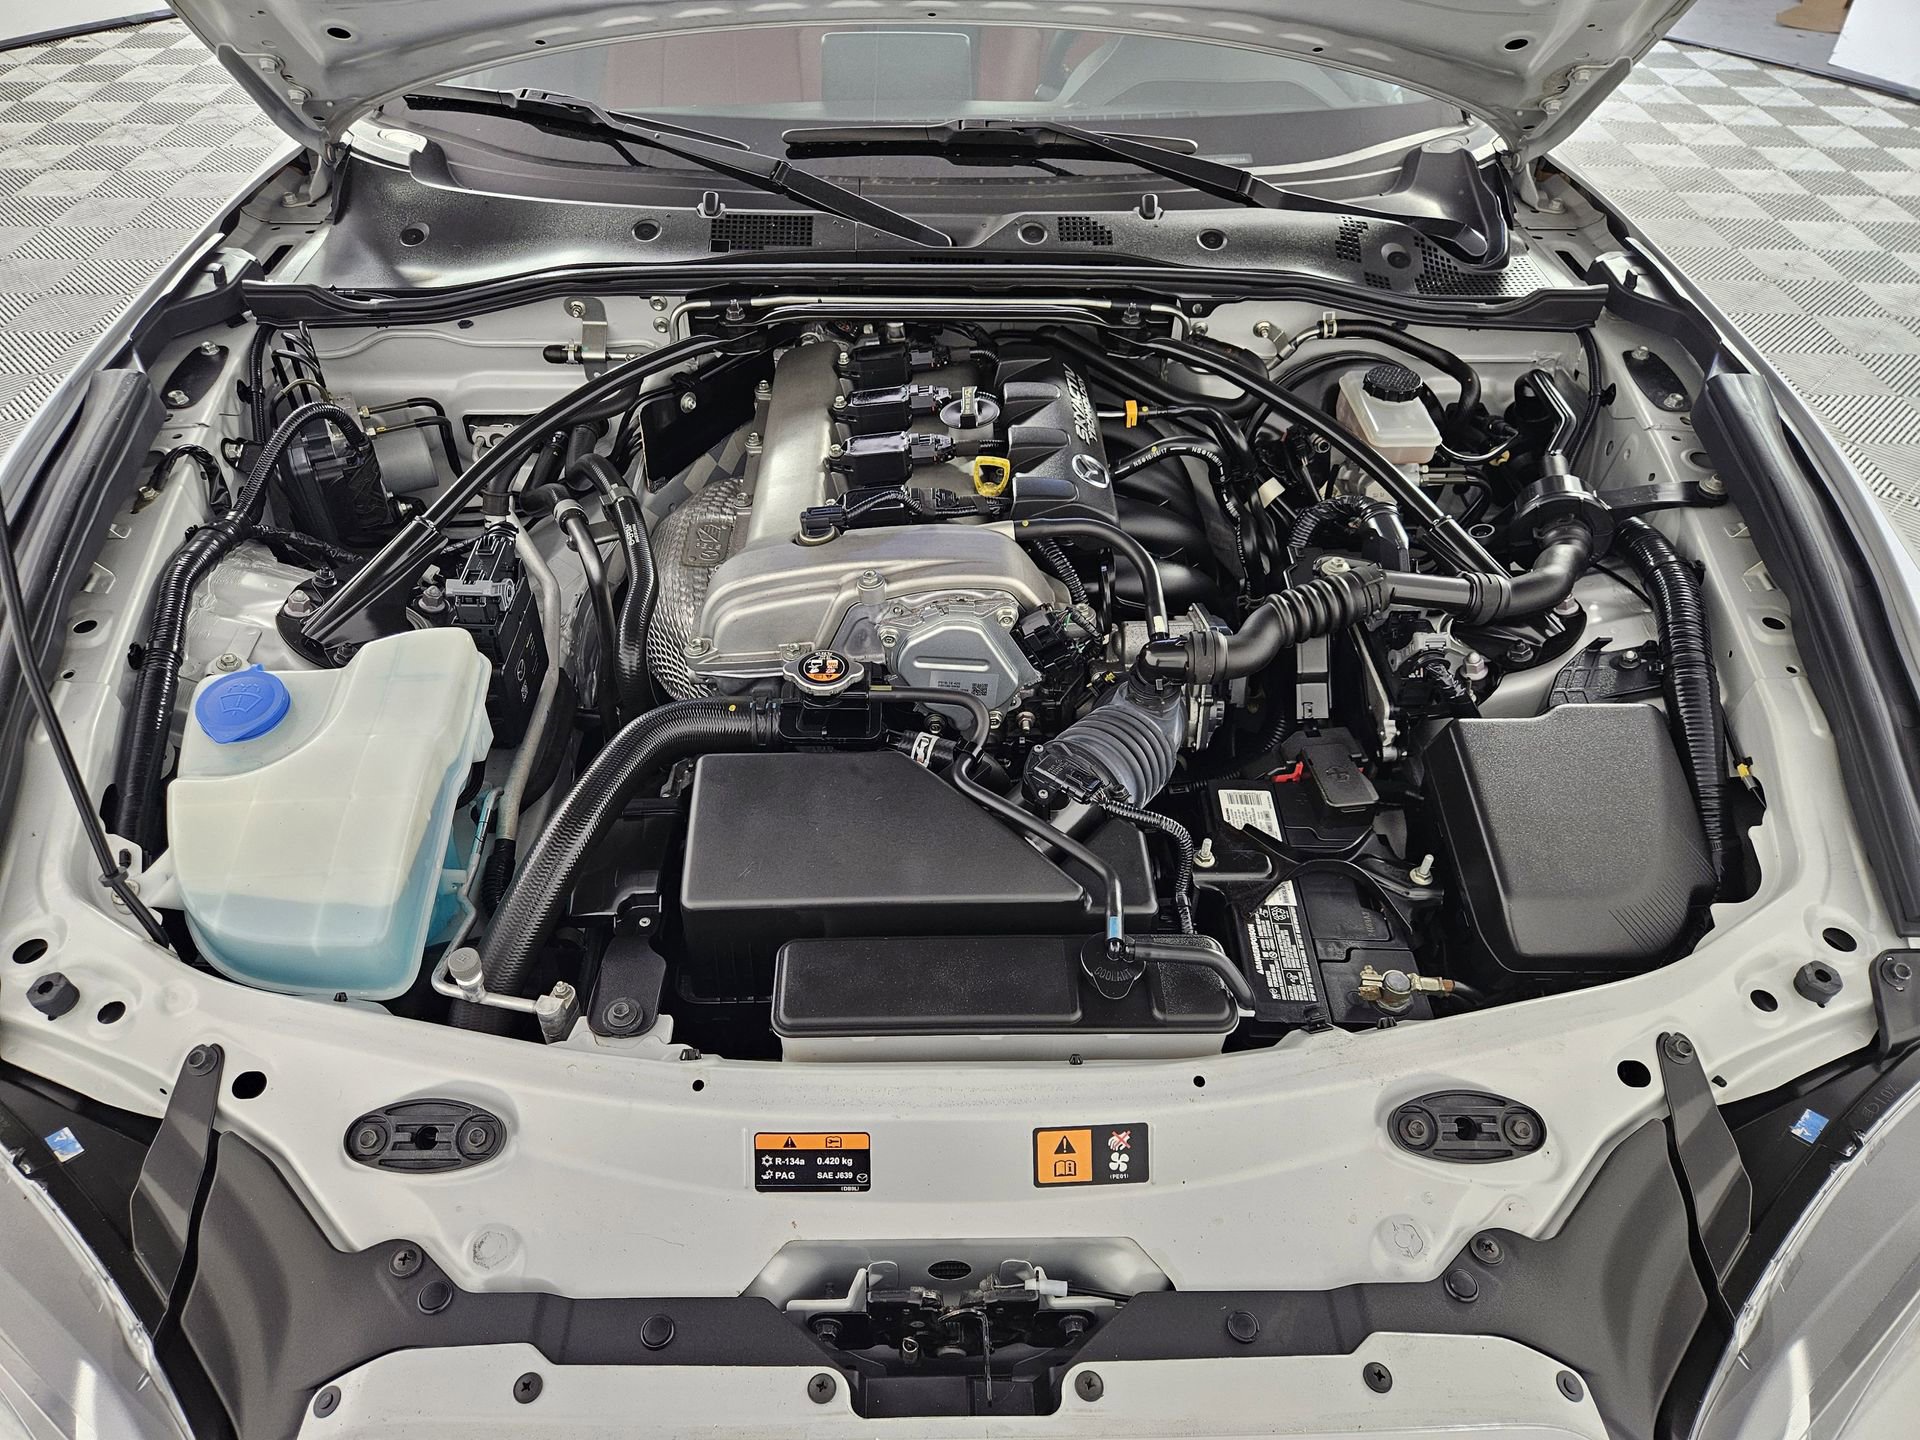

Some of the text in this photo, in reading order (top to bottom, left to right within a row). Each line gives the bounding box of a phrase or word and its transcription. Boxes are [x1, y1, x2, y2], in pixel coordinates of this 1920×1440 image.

[1062, 362, 1091, 446] SKYACTIV
[775, 1157, 853, 1167] R-134a 0.420 kg
[775, 1171, 854, 1180] PAG SAE J639
